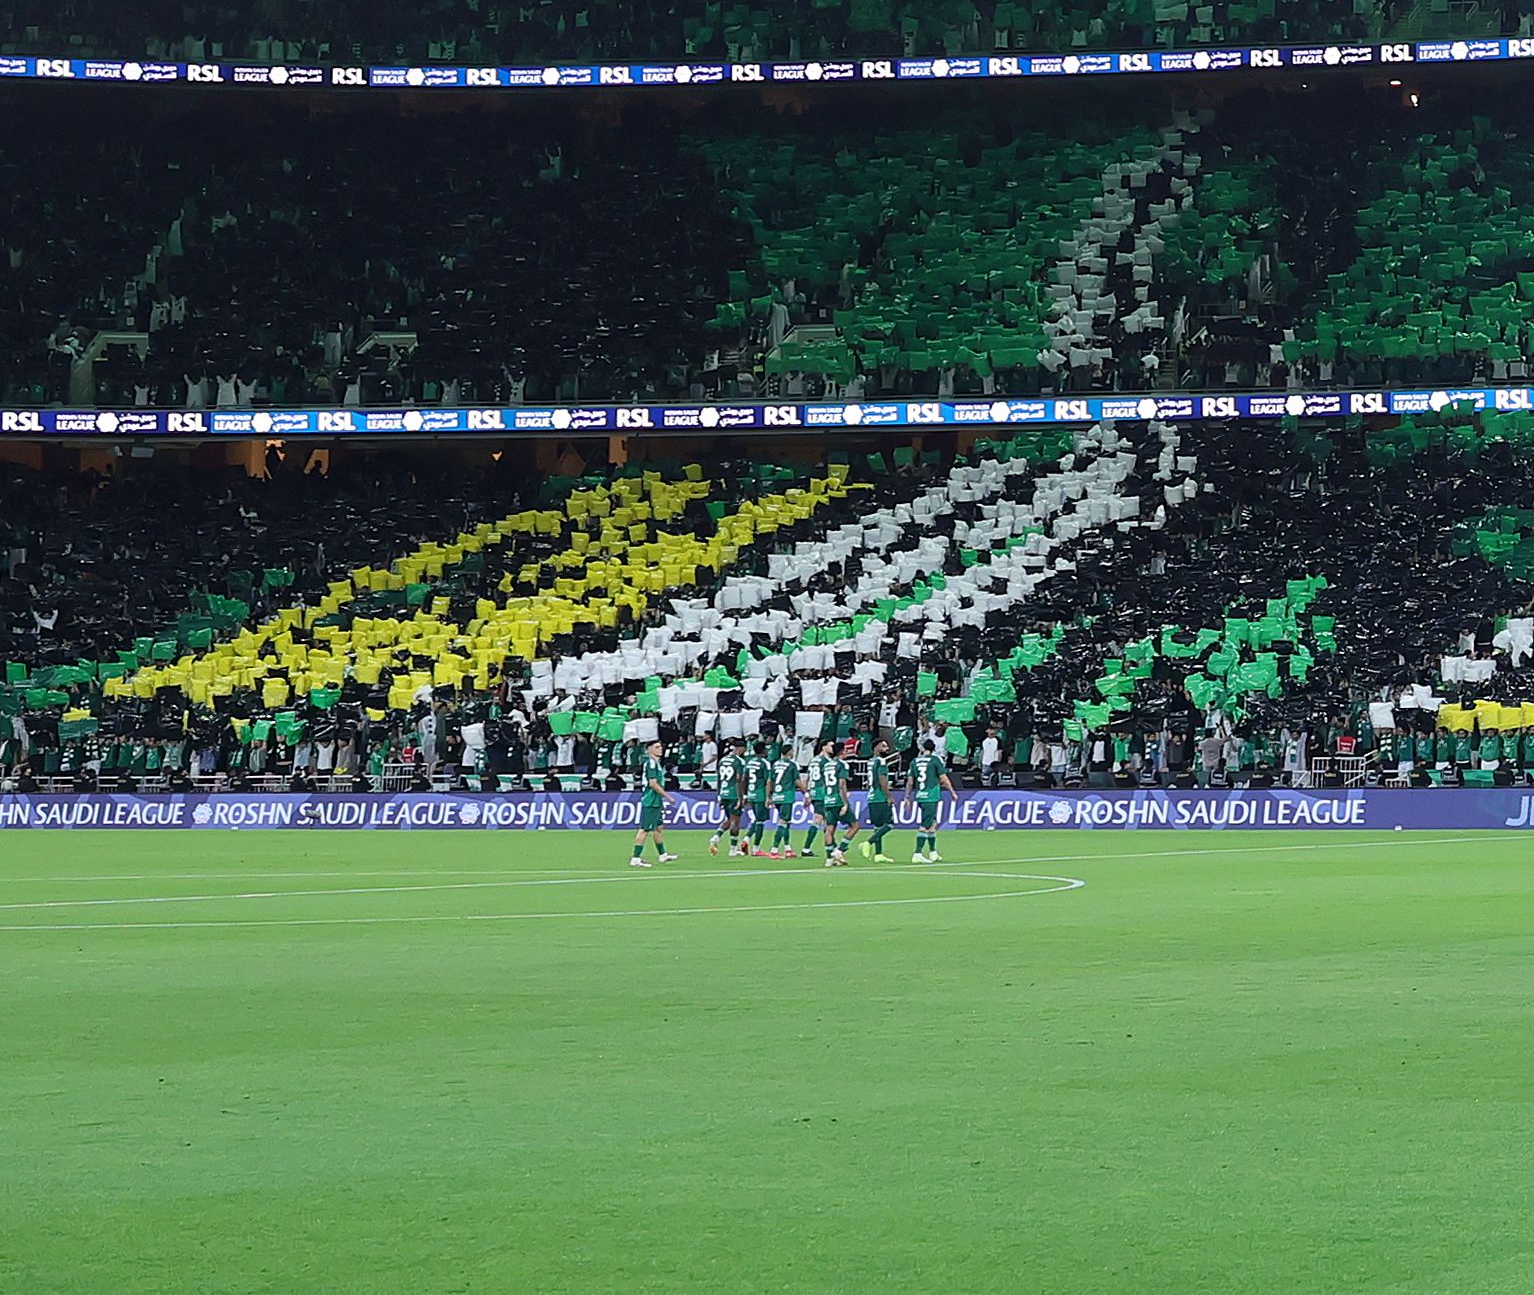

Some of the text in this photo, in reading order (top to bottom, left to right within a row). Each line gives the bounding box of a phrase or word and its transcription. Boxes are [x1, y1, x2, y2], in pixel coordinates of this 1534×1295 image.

[1119, 53, 1152, 71] RSL
[1250, 49, 1282, 67] RSL
[1380, 44, 1414, 62] RSL
[36, 58, 74, 77] RSL
[187, 64, 224, 82] RSL
[599, 66, 634, 84] RSL
[731, 63, 764, 81] RSL
[862, 60, 896, 78] RSL
[988, 57, 1022, 75] RSL
[332, 67, 366, 85] RSL
[466, 68, 500, 85] RSL
[1202, 396, 1240, 417] RSL
[1350, 392, 1388, 413] RSL
[1393, 400, 1430, 411] LEAGUE
[1495, 388, 1532, 410] RSL
[616, 407, 654, 427] RSL
[764, 405, 802, 425] RSL
[906, 402, 944, 423] RSL
[1054, 400, 1092, 420] RSL
[2, 411, 44, 431] RSL
[56, 419, 96, 430] LEAGUE
[167, 413, 208, 432] RSL
[213, 420, 251, 431] LEAGUE
[317, 411, 356, 431] RSL
[366, 419, 403, 430] LEAGUE
[467, 409, 506, 430] RSL
[515, 417, 552, 428] LEAGUE
[719, 766, 735, 782] 99
[748, 769, 757, 783] 5
[774, 769, 786, 785] 7
[823, 770, 837, 786] 13
[917, 766, 927, 783] 3
[35, 802, 100, 825] SAUDI
[103, 802, 186, 825] LEAGUE
[213, 802, 293, 825] ROSHN
[370, 801, 458, 825] LEAGUE
[481, 801, 565, 825] ROSHN
[948, 800, 1045, 824] LEAGUE
[1075, 799, 1367, 824] ROSHN SAUDI LEAGUE
